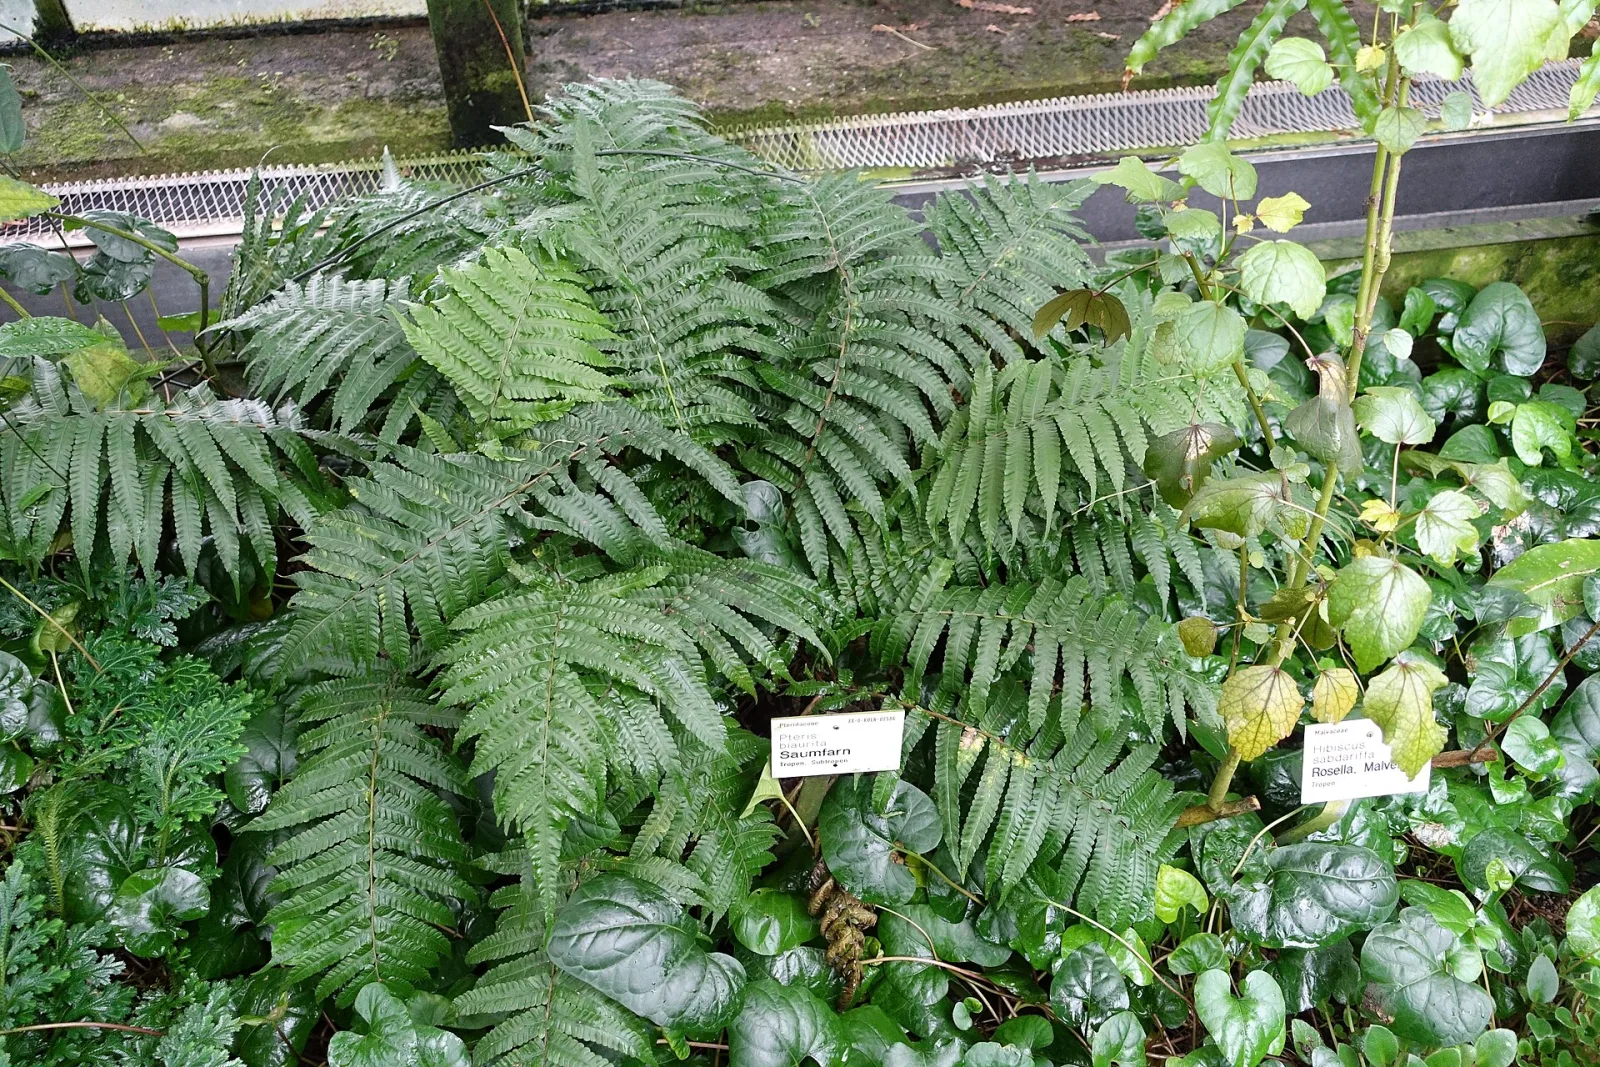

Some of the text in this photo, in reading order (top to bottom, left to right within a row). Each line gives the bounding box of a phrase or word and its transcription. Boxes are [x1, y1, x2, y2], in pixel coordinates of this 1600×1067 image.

[779, 721, 819, 729] Pteridaceae
[779, 733, 817, 741] Pteris
[779, 740, 827, 750] biaurita
[1313, 742, 1366, 754] Hibiscus
[779, 748, 851, 760] Saumfarn
[1312, 750, 1375, 765] sabdariffa
[811, 758, 849, 766] Subtropen
[1311, 780, 1336, 788] Tropen
